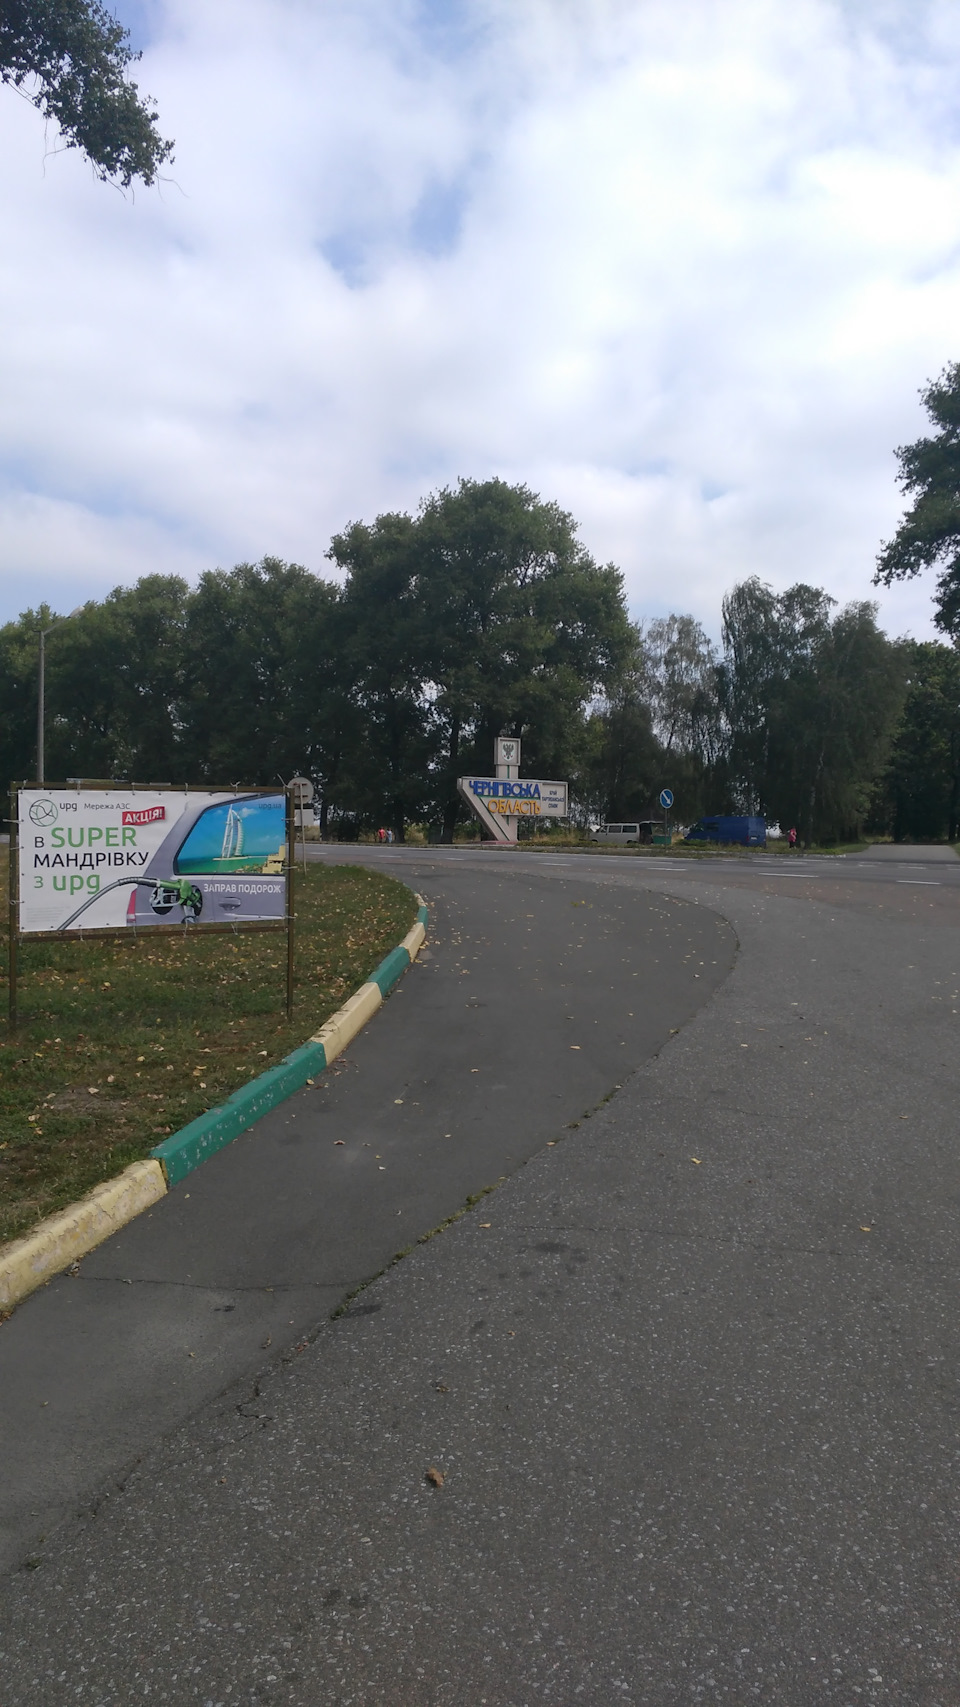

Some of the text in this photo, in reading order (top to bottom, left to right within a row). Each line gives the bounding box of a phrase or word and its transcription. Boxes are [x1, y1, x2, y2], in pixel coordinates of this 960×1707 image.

[60, 802, 78, 812] upg
[488, 800, 540, 814] ОБЛАСТЬ
[125, 808, 163, 823] АКЦІЯ!
[51, 827, 137, 848] SUPER
[34, 852, 149, 870] МАНДРІВКУ
[53, 874, 100, 895] upg
[204, 883, 281, 894] ЗАПРАВ ПОДОРОЖ
